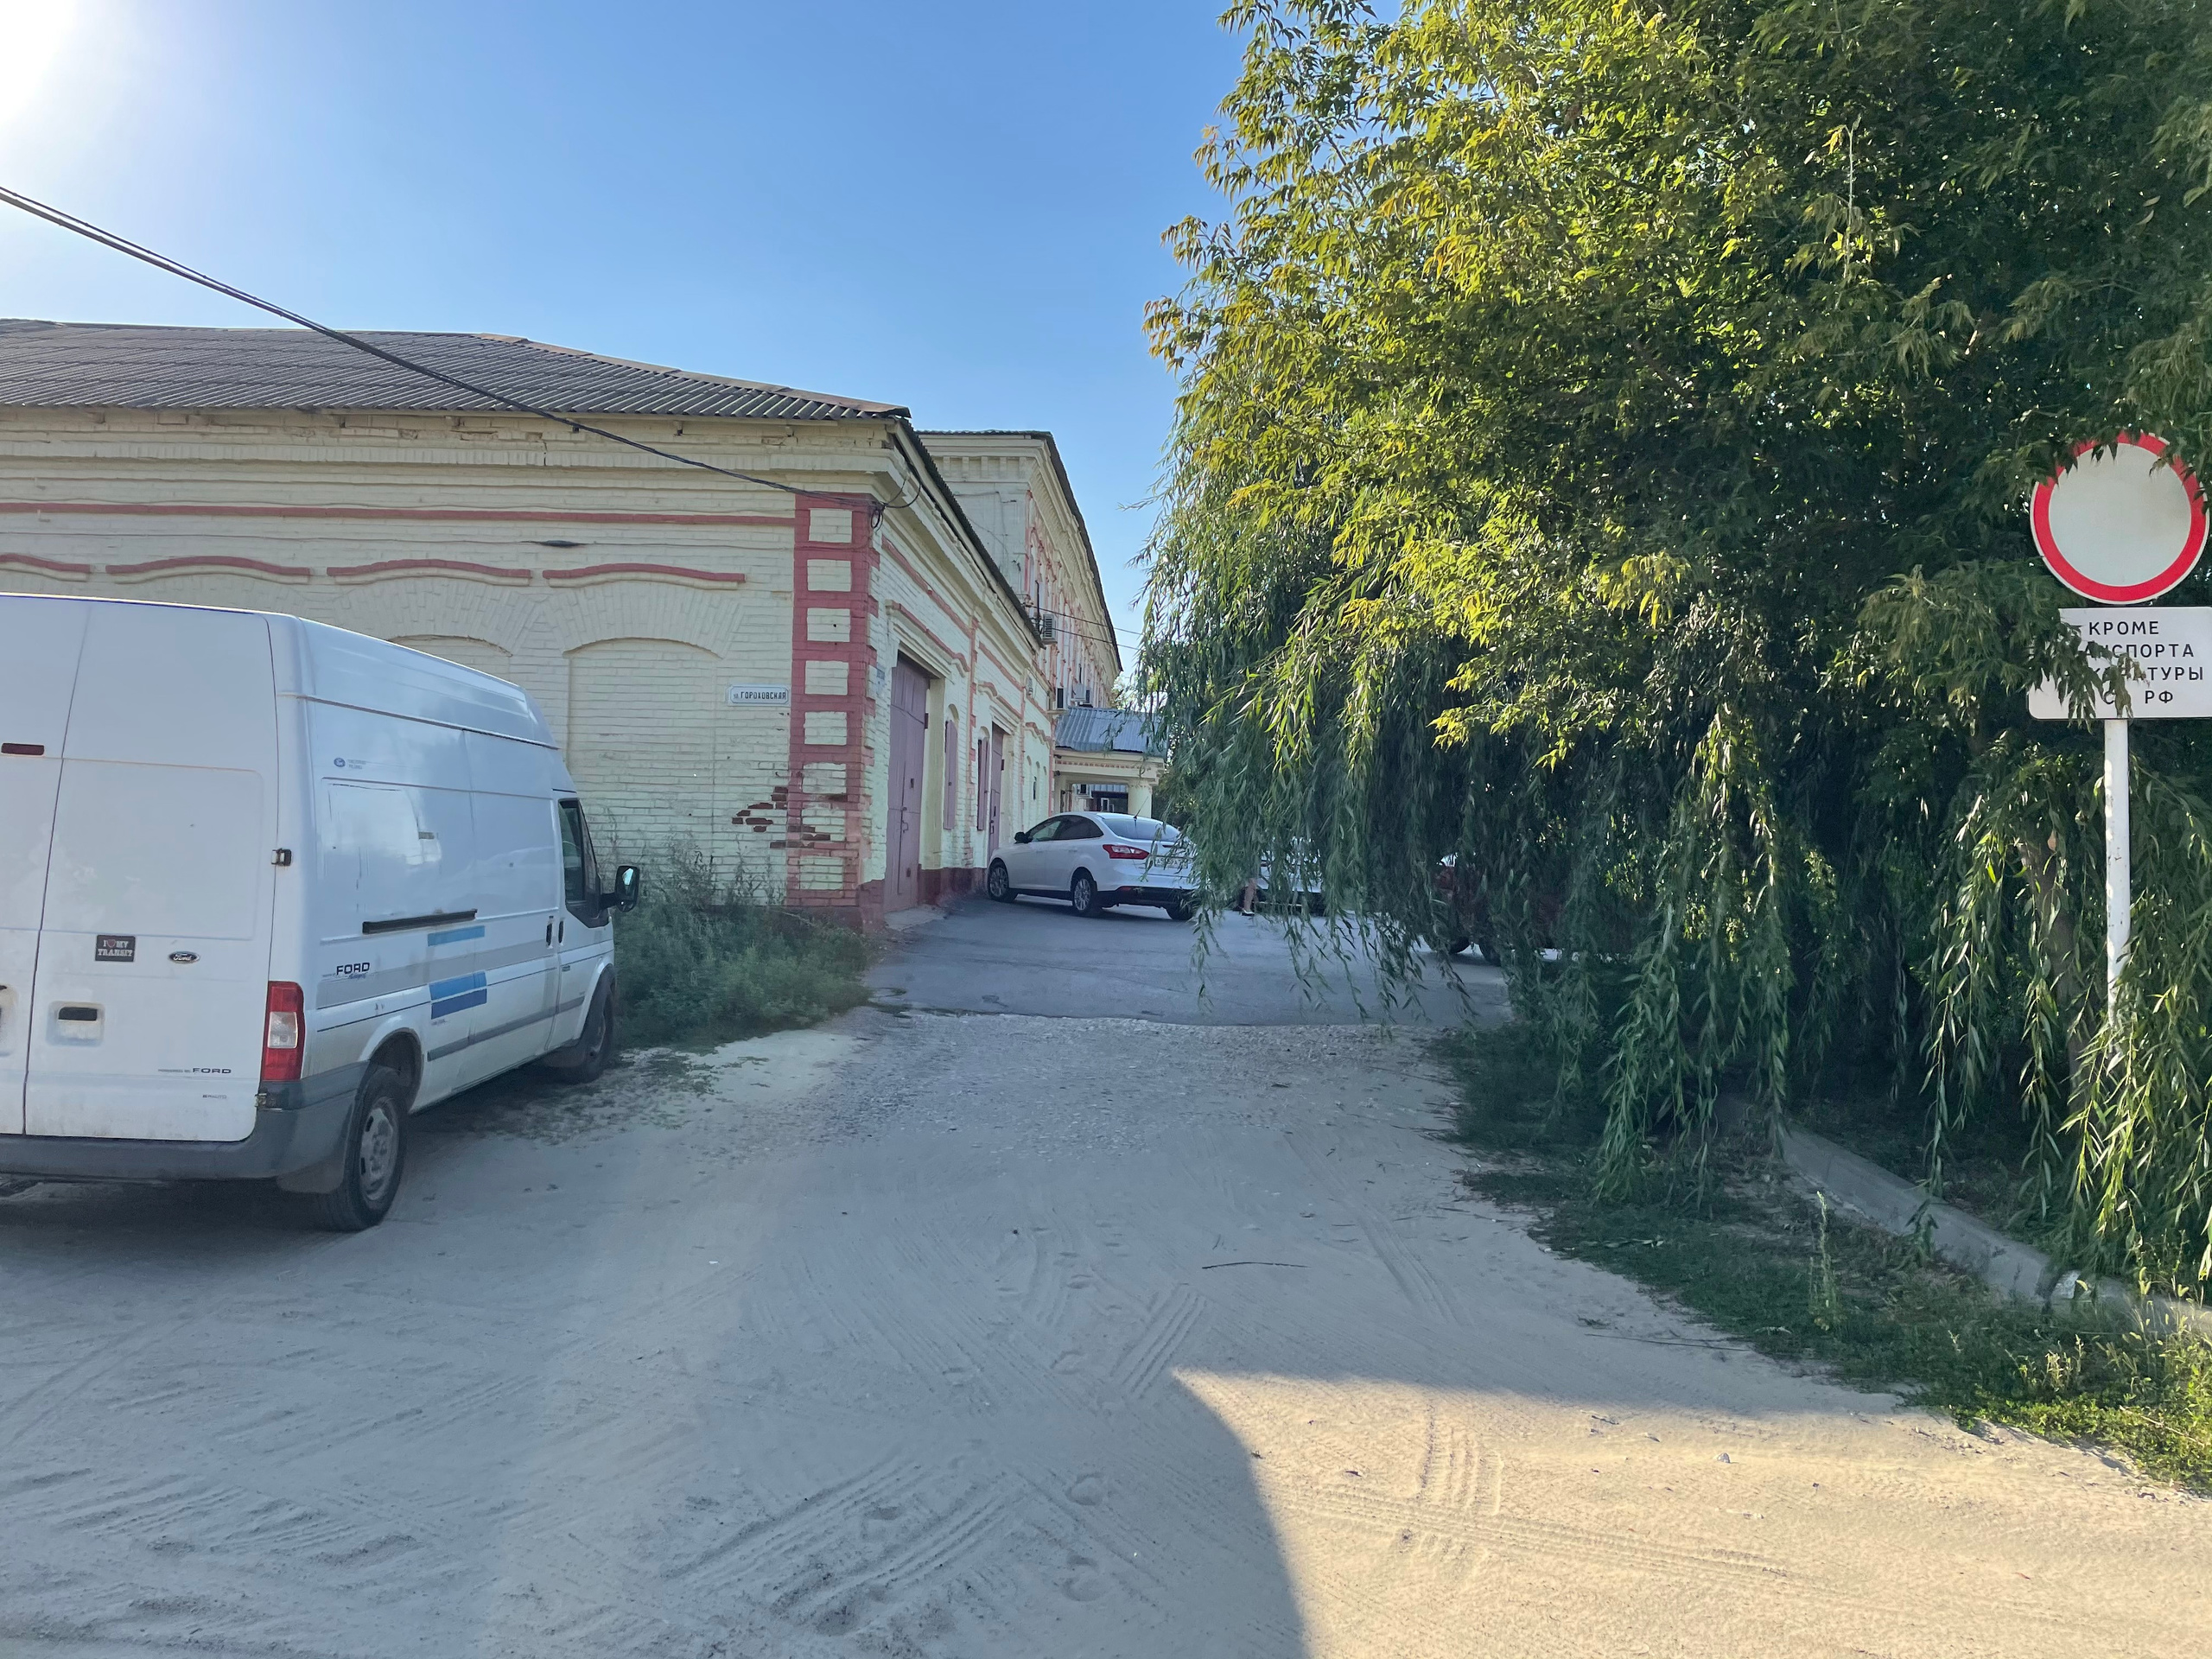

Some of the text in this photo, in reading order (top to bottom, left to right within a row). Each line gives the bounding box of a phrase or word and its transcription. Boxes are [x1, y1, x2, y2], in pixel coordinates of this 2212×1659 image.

[2088, 620, 2159, 636] КРОМЕ
[741, 691, 786, 700] ГОРОХОВСКАЯ
[2145, 690, 2174, 704] РФ
[116, 940, 129, 949] MY
[336, 962, 371, 976] FORD
